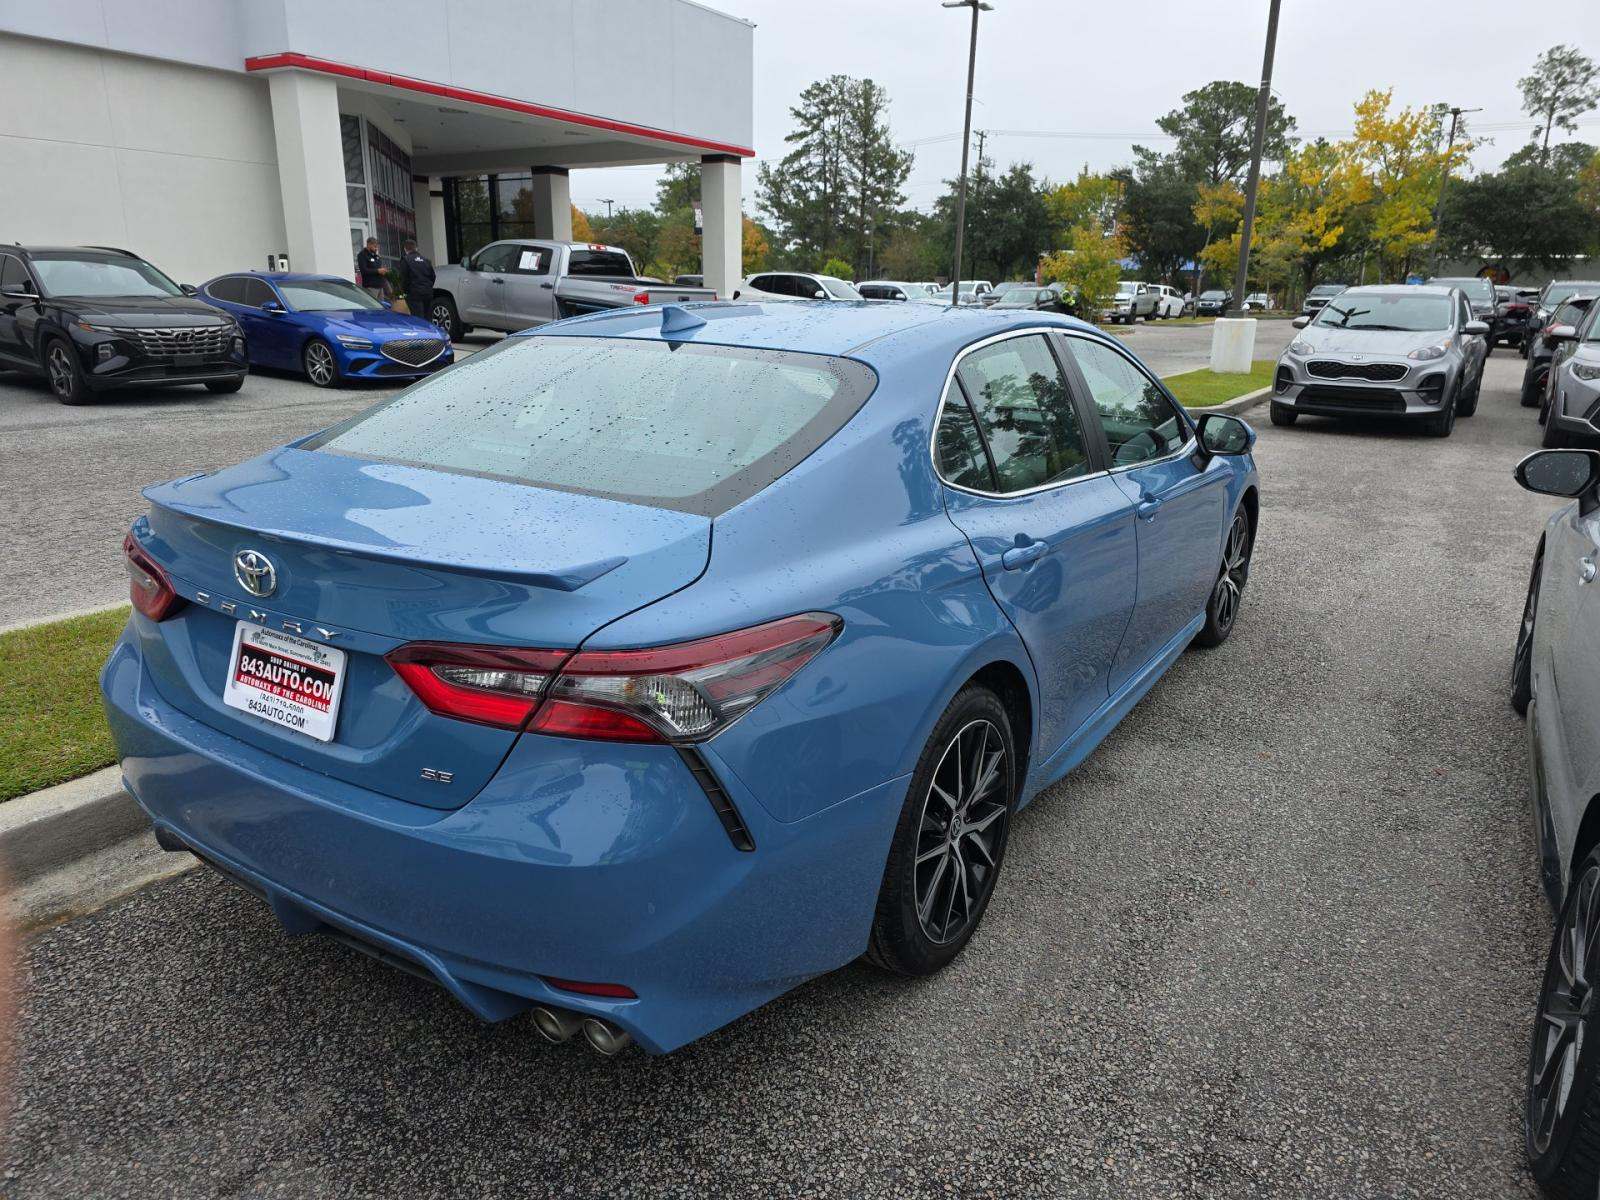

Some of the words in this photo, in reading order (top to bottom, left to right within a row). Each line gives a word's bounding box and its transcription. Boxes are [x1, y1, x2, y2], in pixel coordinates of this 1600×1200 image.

[196, 592, 339, 641] CAMRY
[239, 654, 333, 701] 843AUTO.COM
[239, 674, 271, 691] AUTOMAXX
[272, 685, 281, 694] OF
[282, 688, 294, 699] THE
[295, 693, 330, 713] CAROLINAS
[247, 699, 305, 728] 843AUTO.COM
[420, 767, 454, 784] SE
